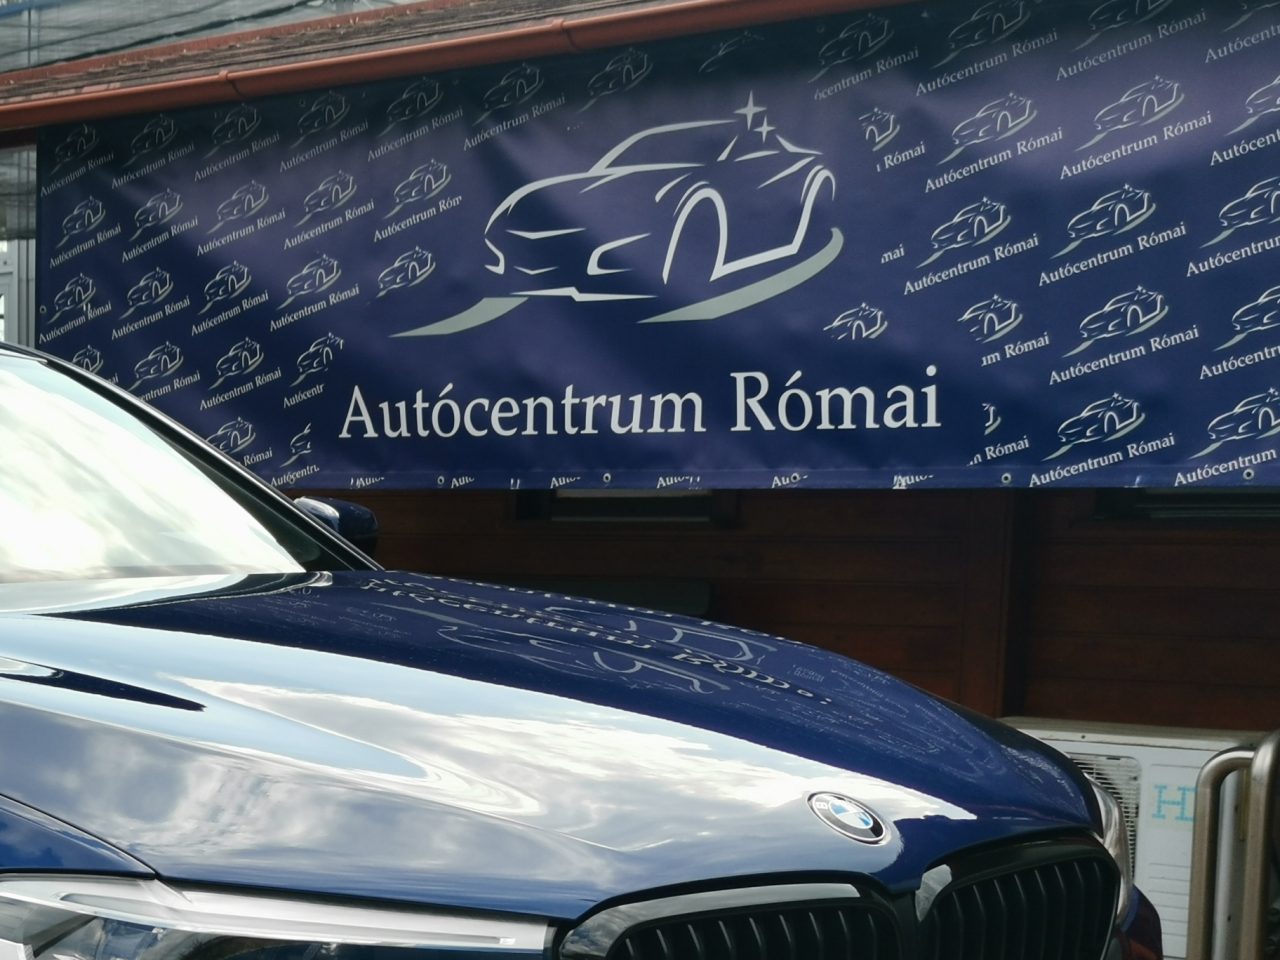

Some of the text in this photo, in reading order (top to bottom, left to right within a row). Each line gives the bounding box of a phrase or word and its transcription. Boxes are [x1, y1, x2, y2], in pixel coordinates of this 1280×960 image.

[876, 46, 919, 75] Római
[915, 28, 1058, 96] Autócentrum Római
[1056, 8, 1207, 81] Autócentrum Római
[884, 142, 926, 170] Római
[925, 127, 1063, 193] Autócentrum Római
[1060, 110, 1213, 180] Autócentrum Római
[374, 206, 436, 243] Autócentrum
[904, 233, 1039, 295] Autócentrum Római
[1038, 221, 1187, 286] Autócentrum Római
[270, 284, 360, 332] Autócentrum Római
[1005, 332, 1050, 358] Római
[1049, 325, 1200, 385] Autócentrum Római
[255, 366, 282, 387] Római
[339, 364, 942, 438] Autócentrum Római
[986, 435, 1030, 461] Római
[1028, 433, 1175, 488] Autócentrum Római
[1174, 448, 1277, 487] Autócentrum
